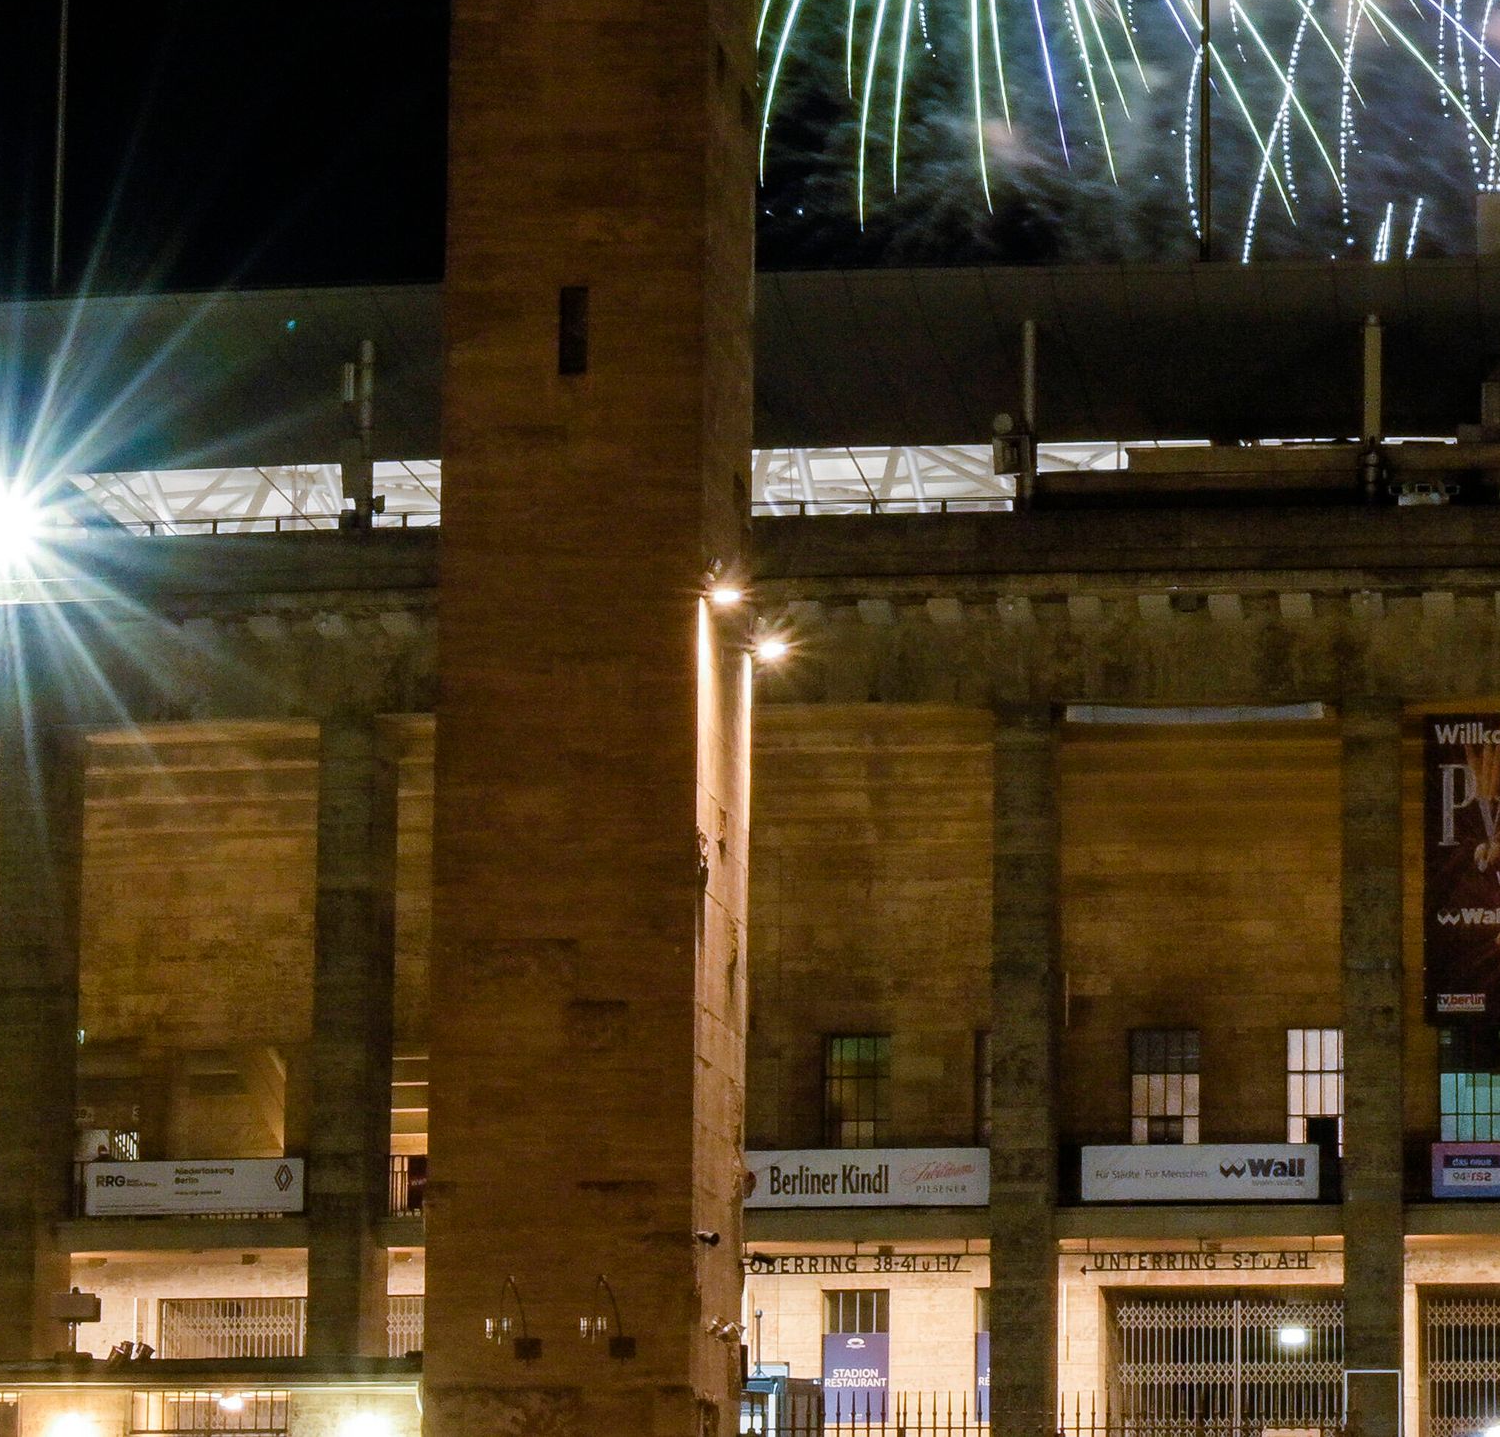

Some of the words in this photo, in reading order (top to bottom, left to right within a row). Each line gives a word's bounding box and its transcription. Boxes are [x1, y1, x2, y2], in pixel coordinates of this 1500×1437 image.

[1247, 1158, 1305, 1178] Wall
[96, 1175, 126, 1188] RRG
[769, 1165, 838, 1196] Berliner
[841, 1164, 889, 1194] Kindl
[915, 1184, 968, 1194] PILSENER
[874, 1256, 916, 1272] 38-41
[1093, 1253, 1215, 1269] UNTERRING
[1277, 1253, 1308, 1268] A-H
[832, 1368, 878, 1378] STADION
[824, 1377, 888, 1388] RESTAURANT
